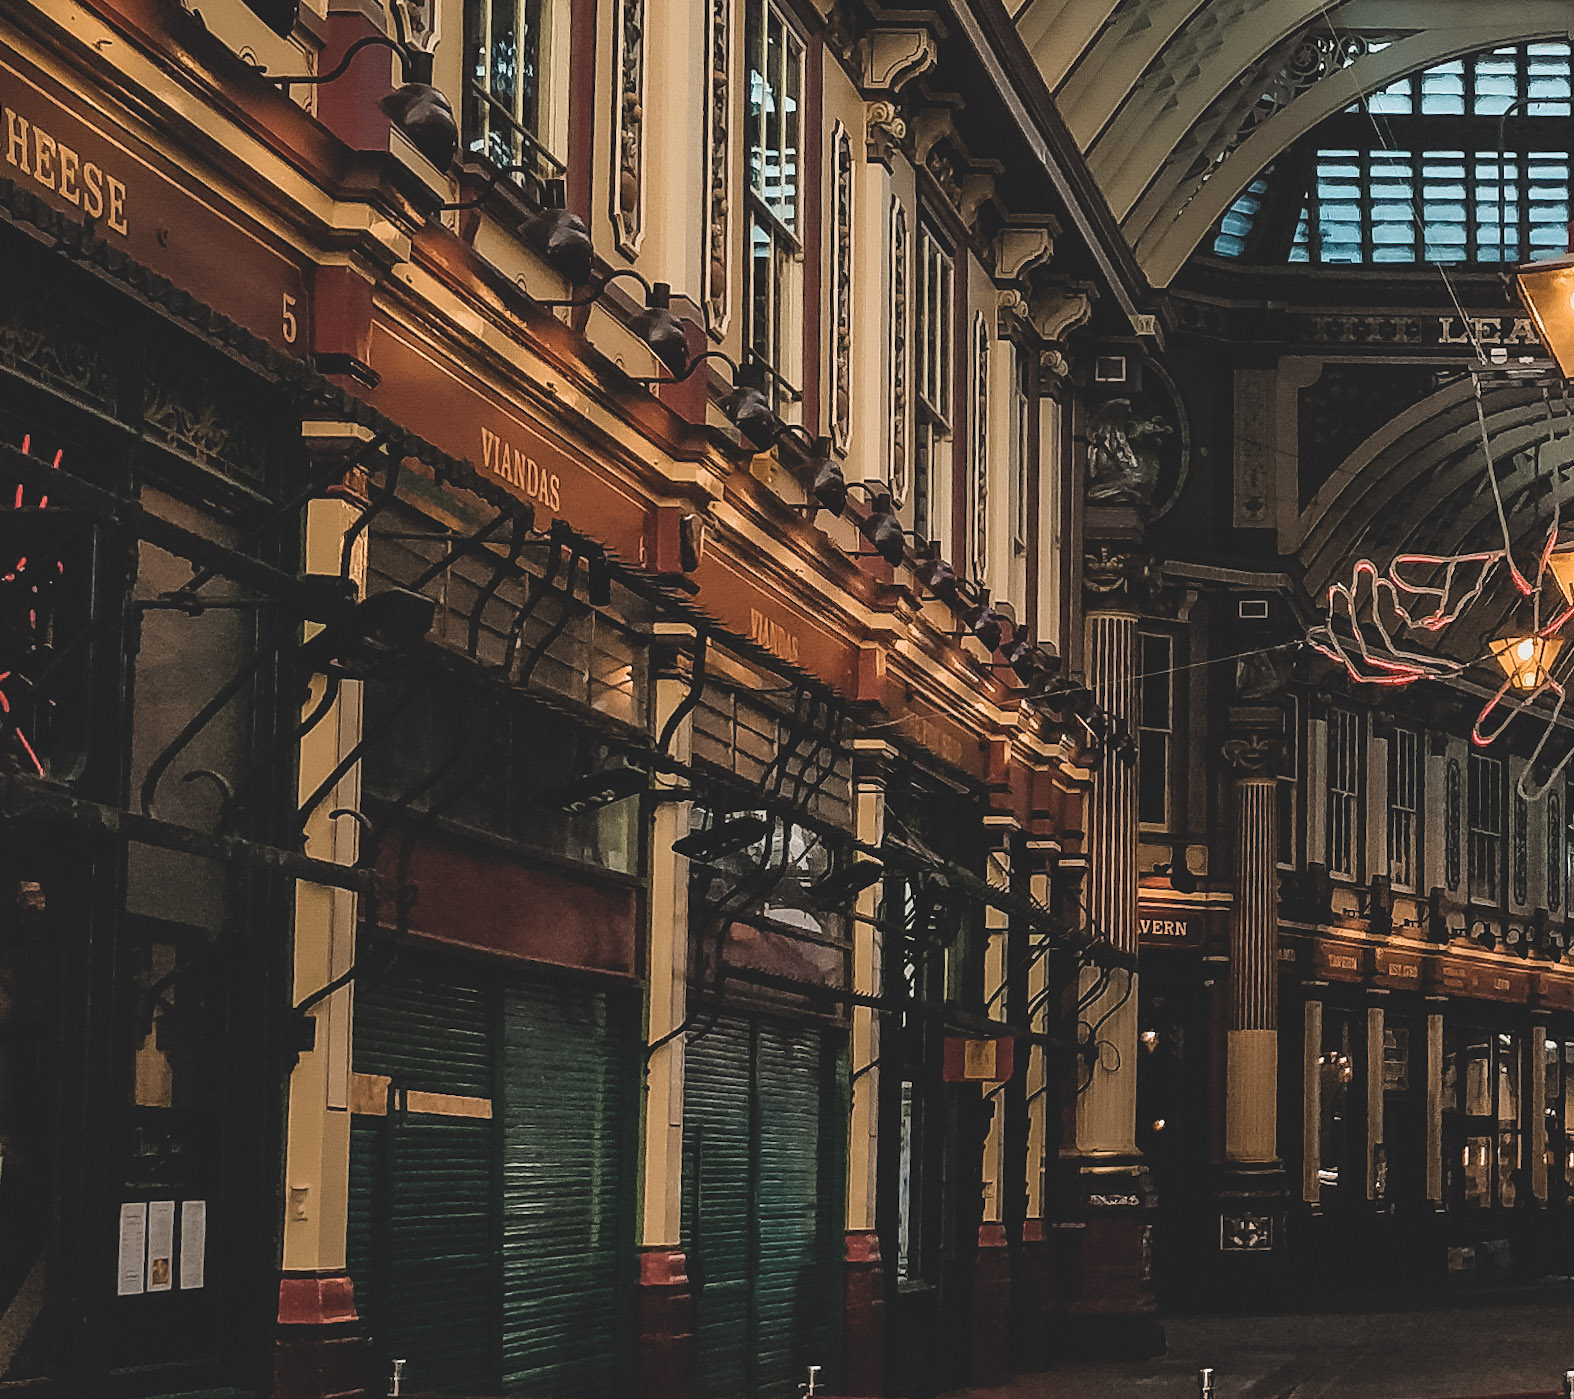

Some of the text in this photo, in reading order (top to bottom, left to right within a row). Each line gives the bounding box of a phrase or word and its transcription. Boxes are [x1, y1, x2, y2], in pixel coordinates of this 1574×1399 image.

[0, 107, 128, 236] HEESE
[282, 292, 297, 343] 5
[481, 426, 560, 512] VIANDAS
[1137, 919, 1187, 936] VERN
